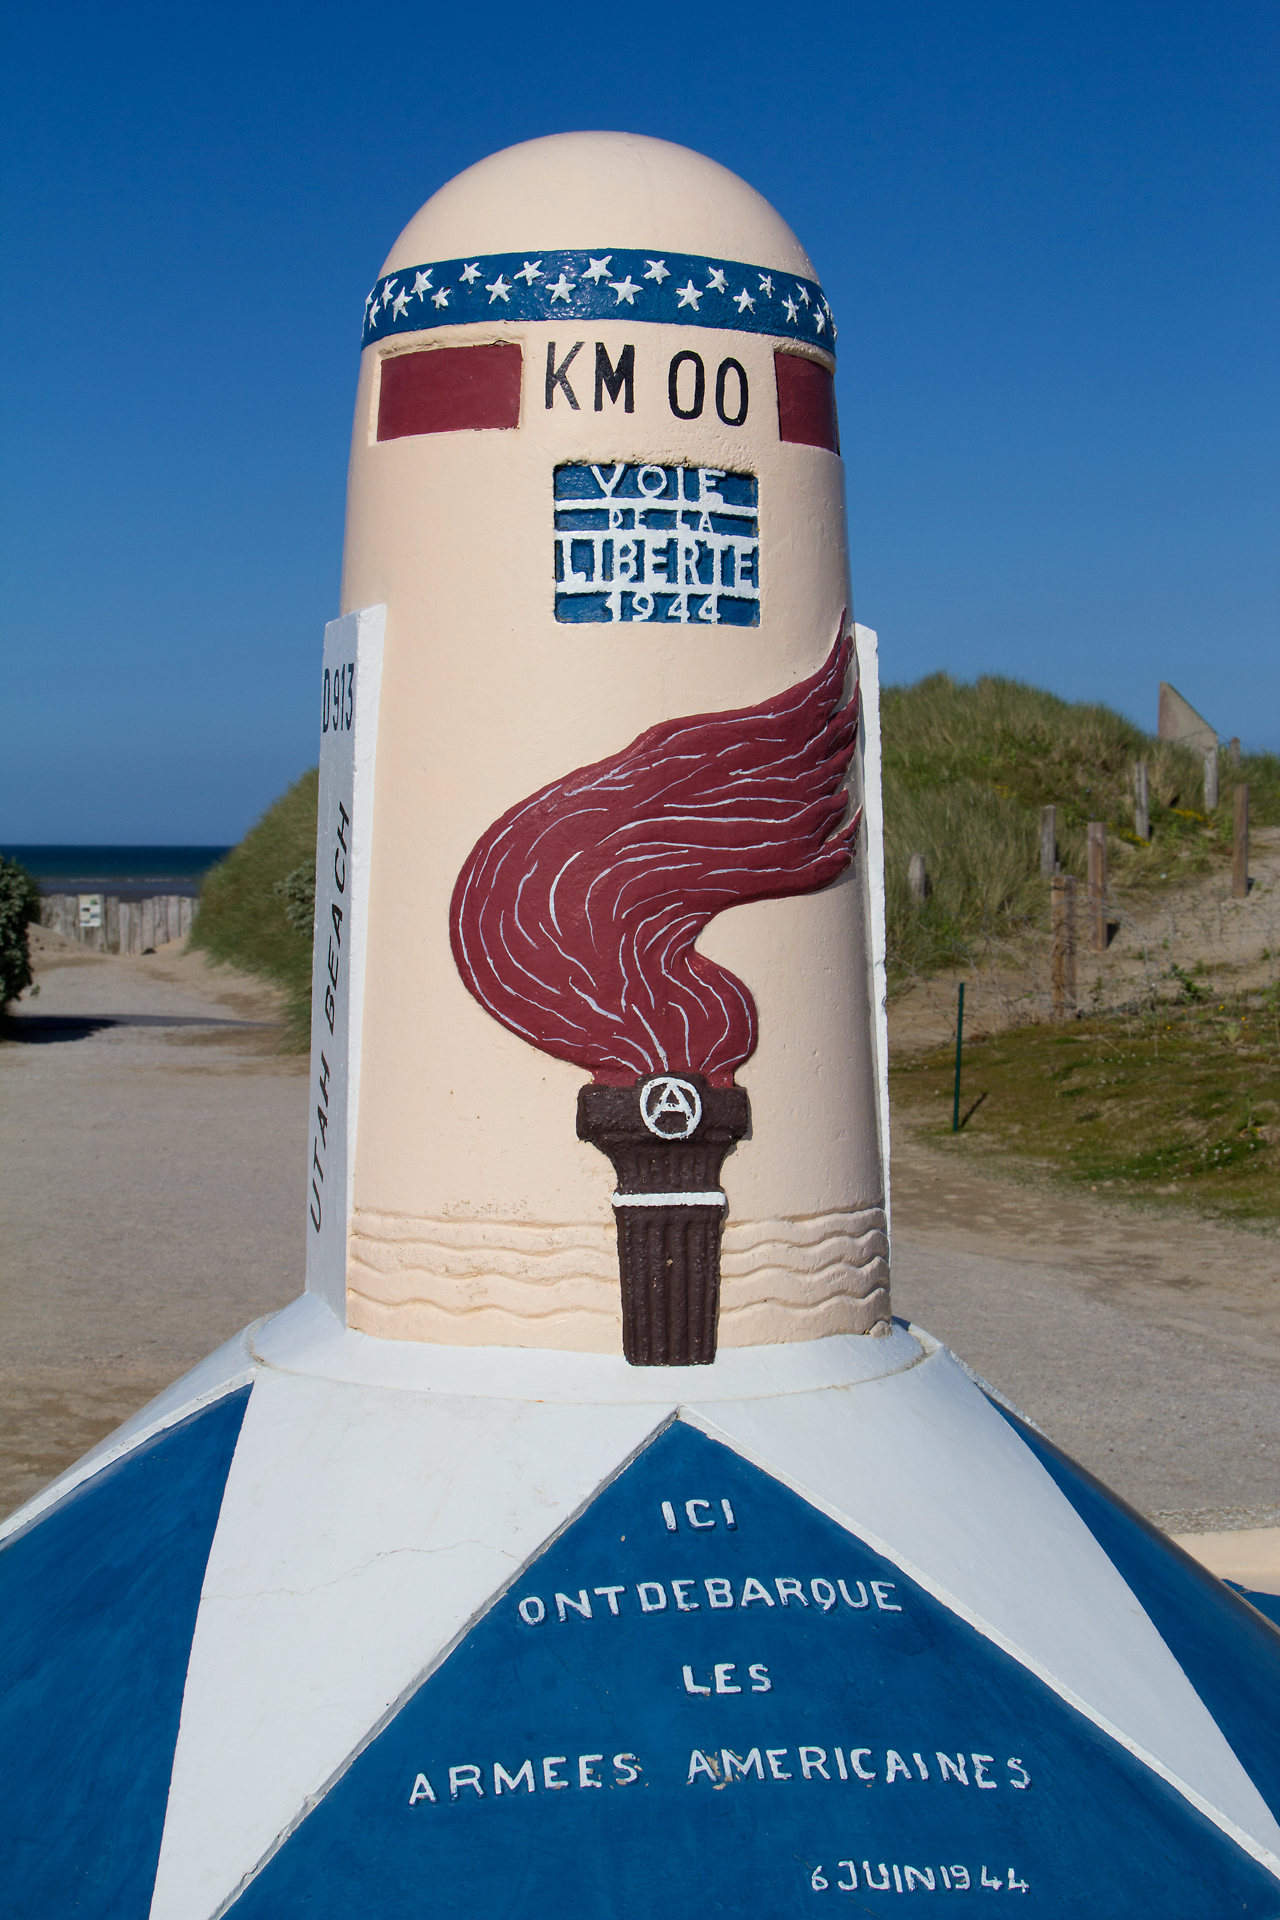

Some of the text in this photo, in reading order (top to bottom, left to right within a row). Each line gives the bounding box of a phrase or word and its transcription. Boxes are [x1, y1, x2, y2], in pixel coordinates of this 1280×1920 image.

[545, 341, 636, 413] KM
[590, 464, 727, 505] VOIE
[609, 509, 714, 533] DE LA
[562, 537, 753, 586] LIBERTE
[605, 592, 722, 623] 1944
[310, 801, 350, 1233] UTAH BEACH
[661, 1498, 738, 1531] ICI
[682, 1663, 773, 1695] LES
[408, 1746, 1033, 1806] ARMEES AMERICAINES
